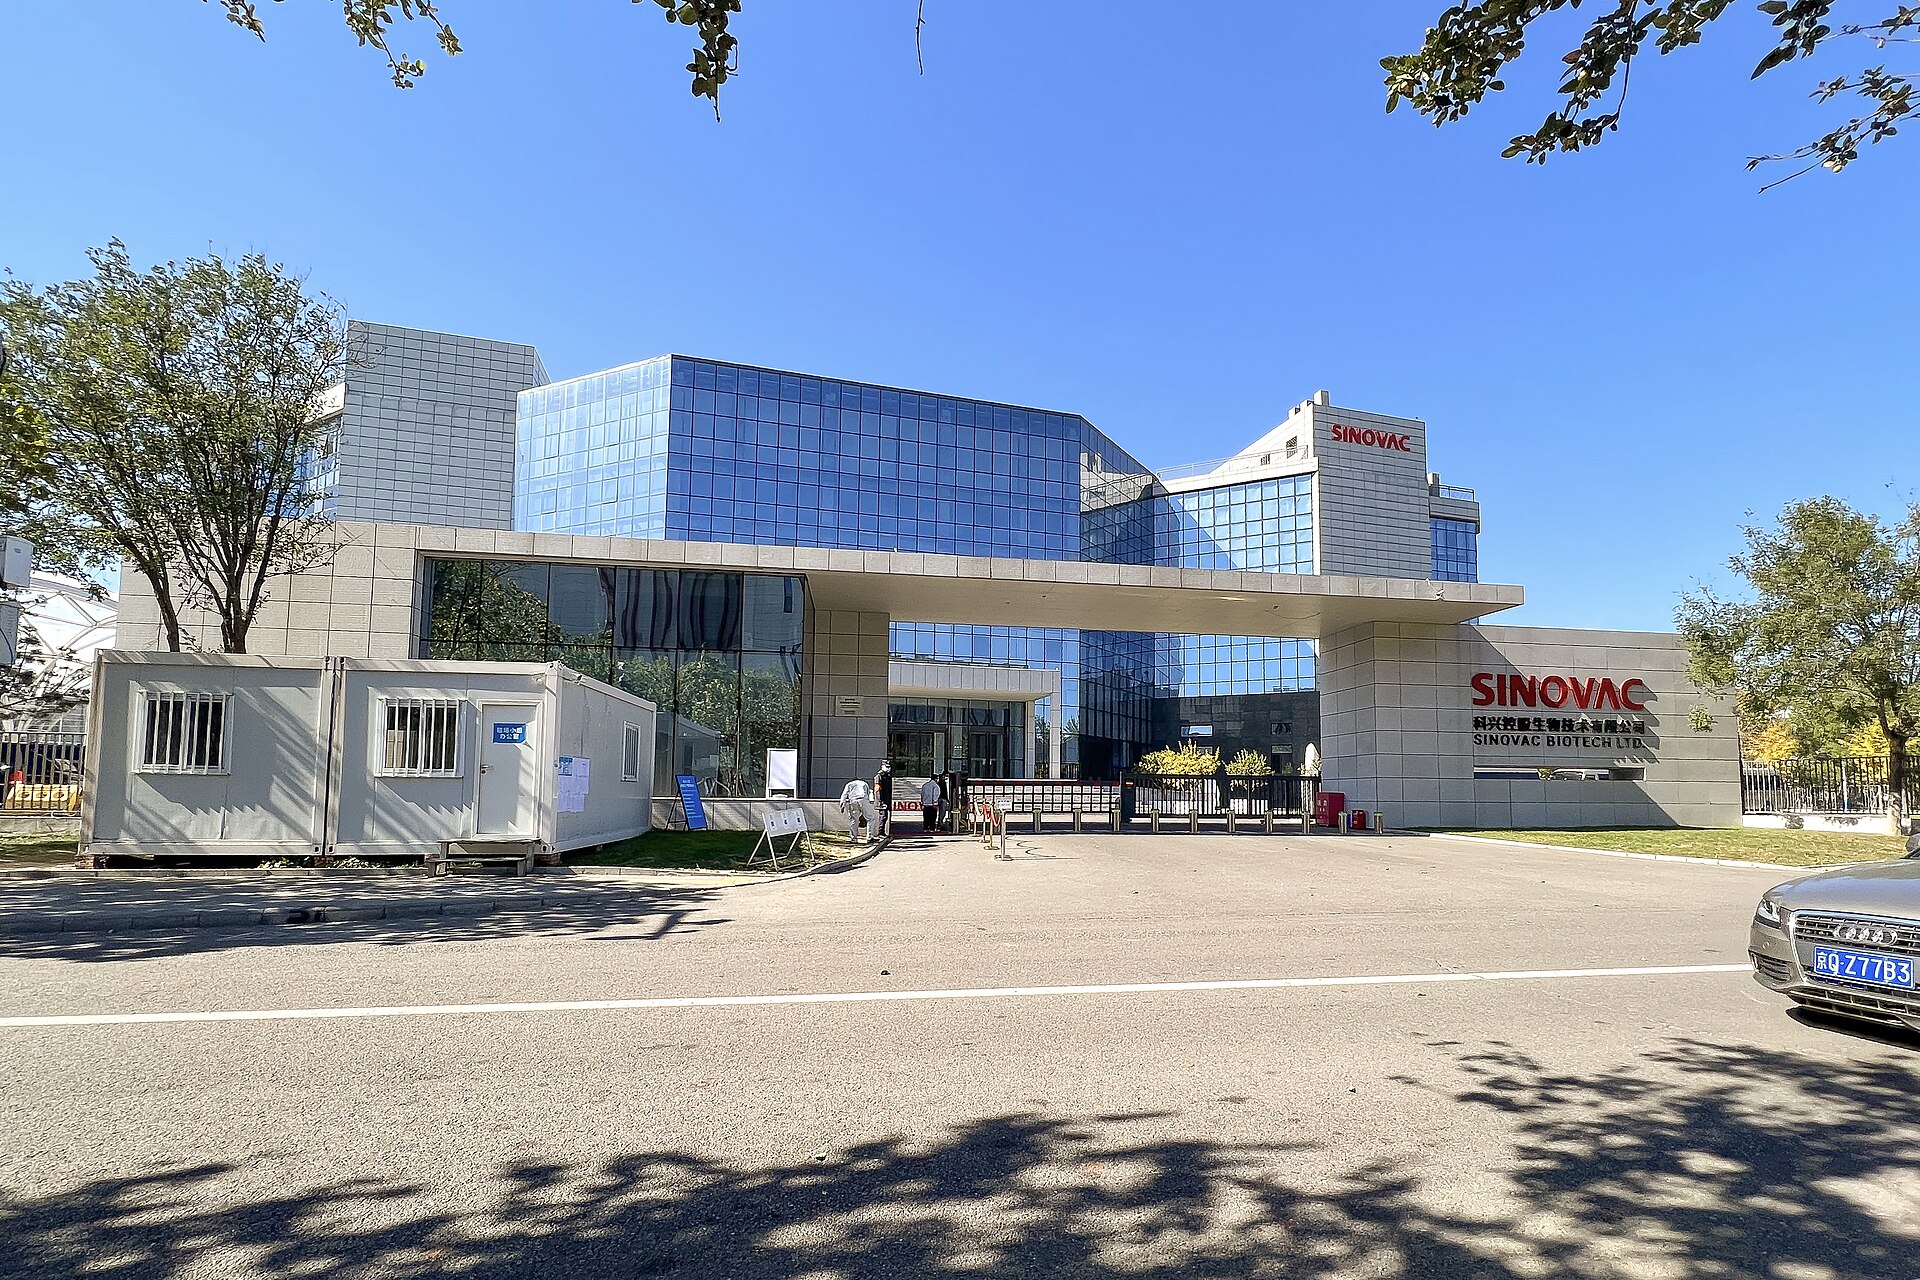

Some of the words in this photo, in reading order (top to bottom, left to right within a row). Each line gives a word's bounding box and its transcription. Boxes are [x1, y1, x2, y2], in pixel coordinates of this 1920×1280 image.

[1331, 423, 1411, 452] SINOVAC
[1471, 672, 1646, 711] SINOVAC
[1472, 715, 1646, 735] 科兴控股生物技术有限公司
[1473, 734, 1541, 747] SINOVAC
[1546, 735, 1612, 749] BIOTECH
